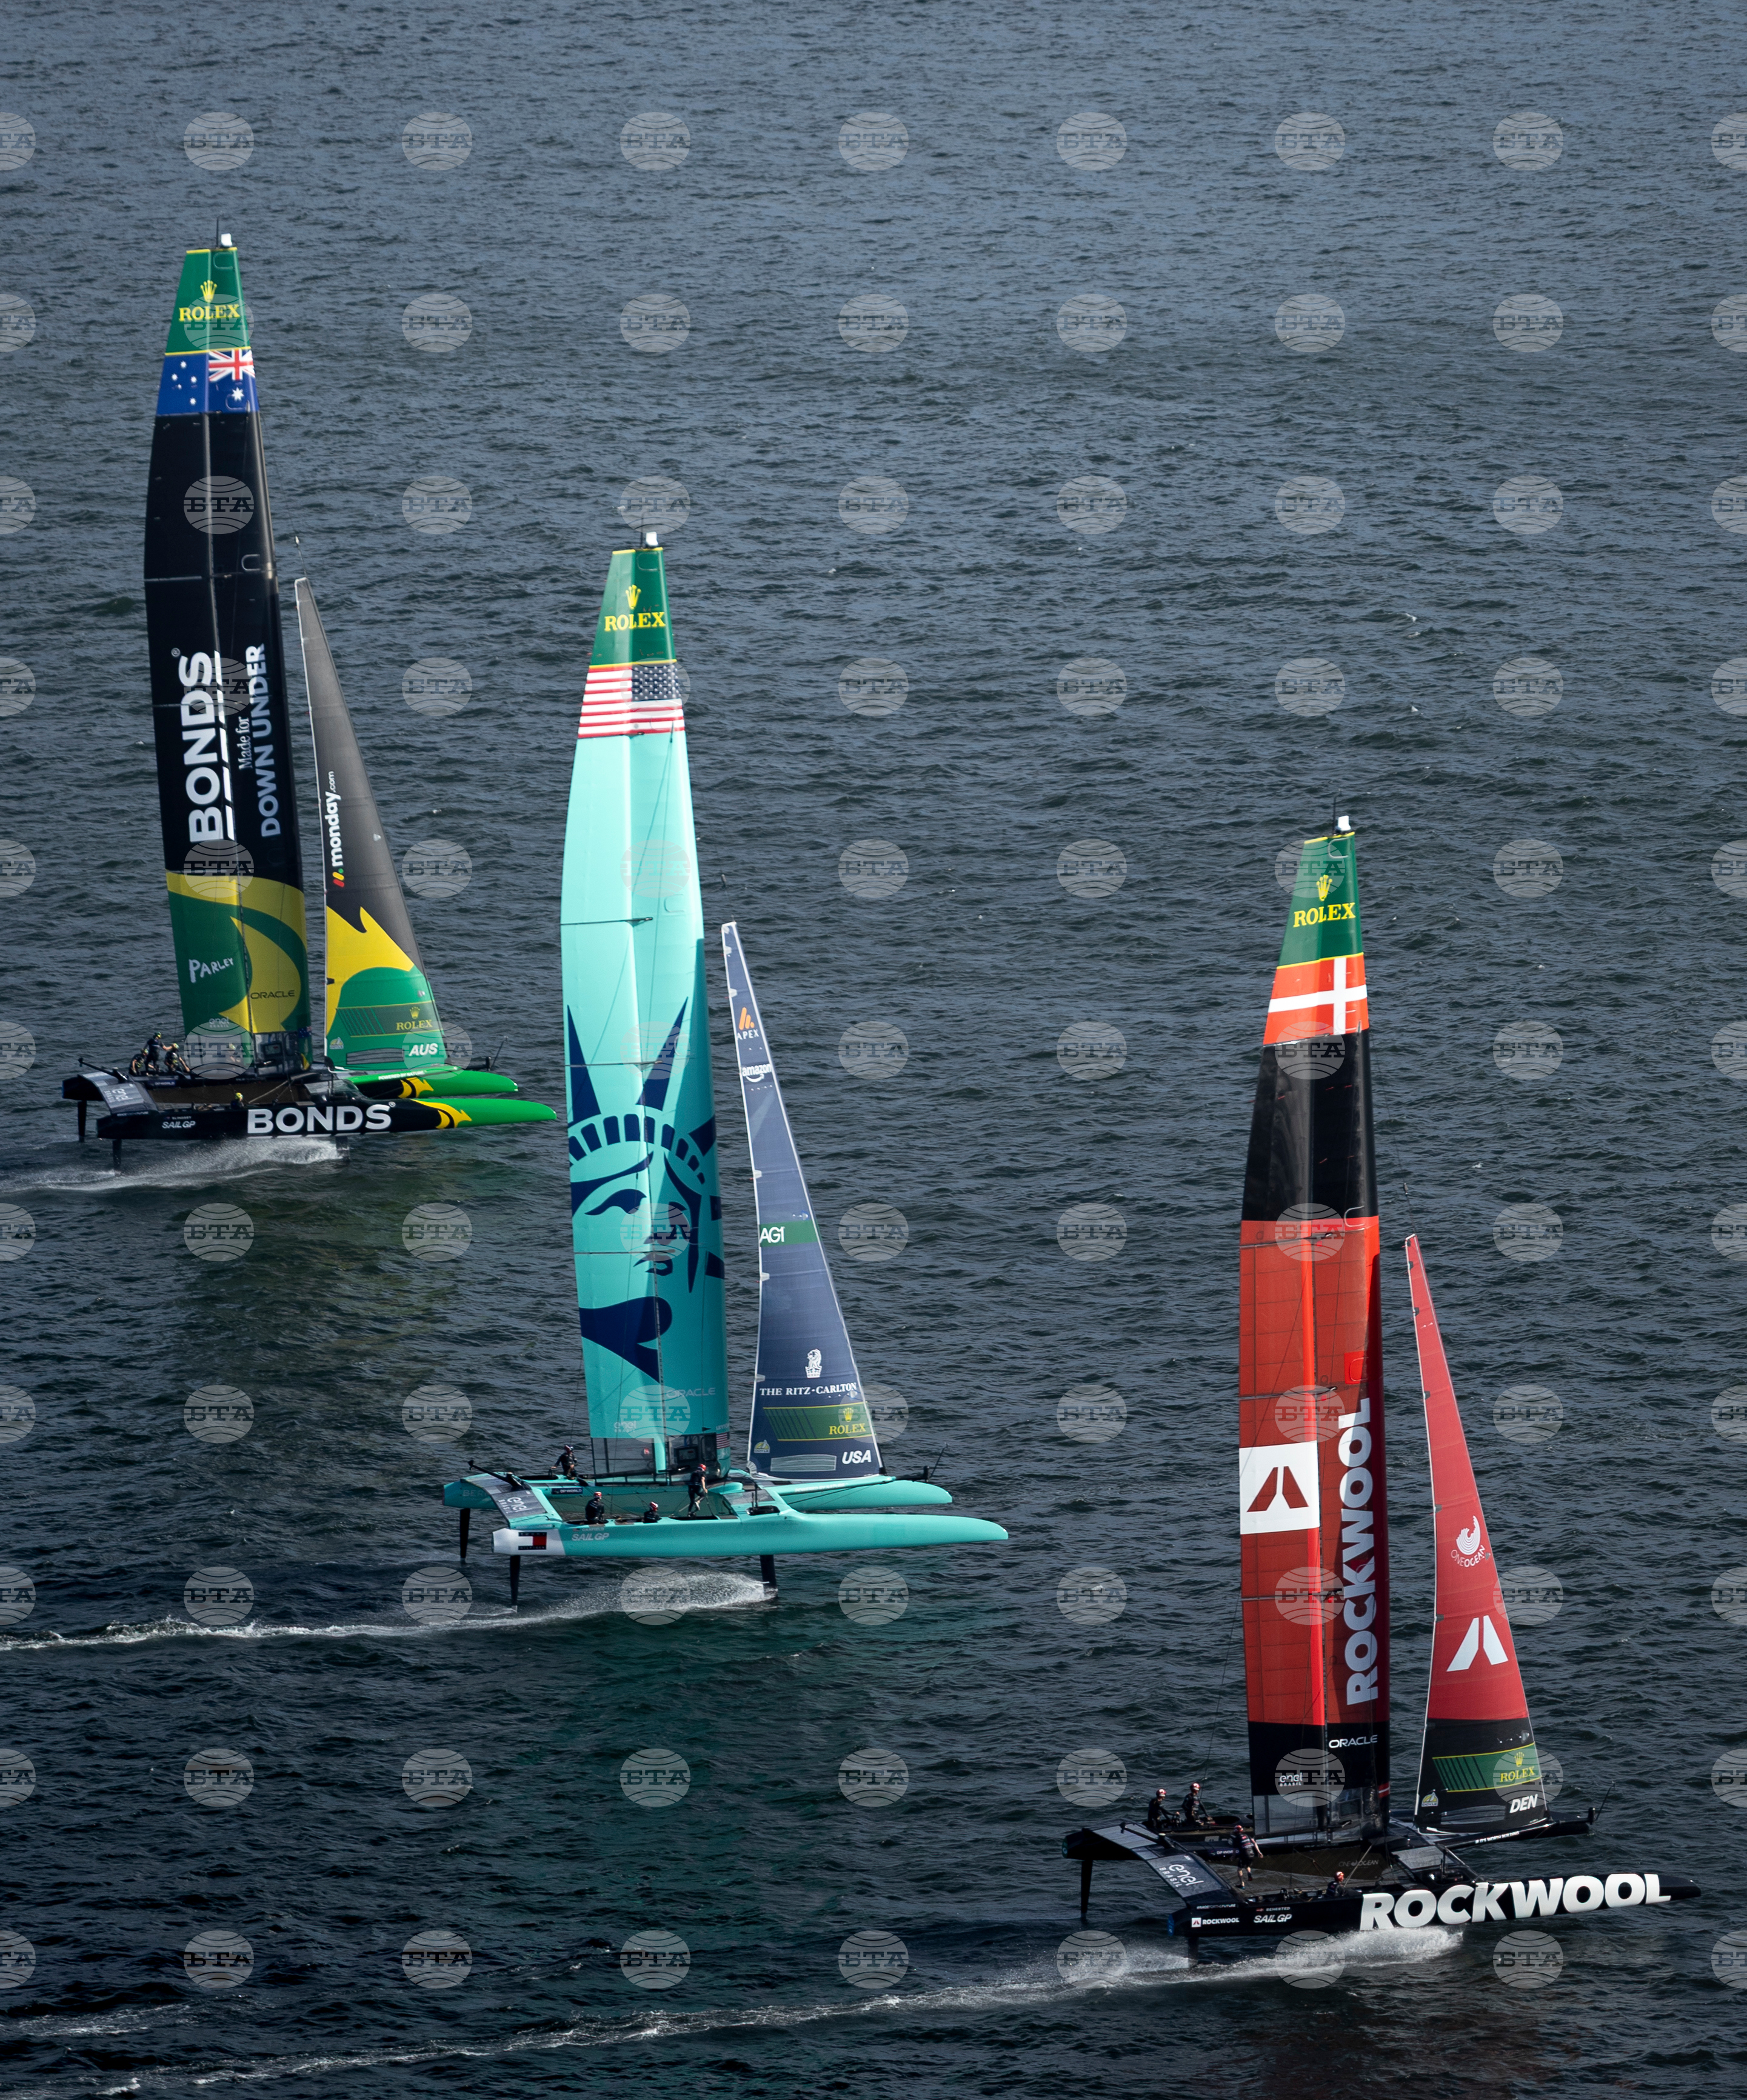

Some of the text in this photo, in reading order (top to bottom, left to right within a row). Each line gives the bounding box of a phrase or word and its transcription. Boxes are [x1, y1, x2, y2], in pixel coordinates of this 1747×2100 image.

[178, 304, 241, 322] ROLEX
[604, 611, 666, 632] ROLEX
[235, 716, 253, 770] Made for
[246, 644, 281, 838] DOWN UNDER
[324, 770, 342, 868] monday.com
[1293, 902, 1356, 927] ROLEX
[250, 990, 295, 999] ORACLE
[396, 1019, 433, 1031] ROLEX
[737, 1028, 760, 1041] APEX
[409, 1043, 438, 1056] AUS
[742, 1063, 772, 1076] amazon
[760, 1226, 784, 1244] AG1
[666, 1387, 716, 1399] ORACLE
[613, 1421, 636, 1429] enel
[829, 1423, 866, 1436] ROLEX
[842, 1450, 872, 1465] USA
[1338, 1397, 1378, 1705] ROCKWOOL
[1329, 1735, 1378, 1748] ORACLE
[1279, 1772, 1303, 1783] enel
[1499, 1766, 1535, 1783] ROLEX
[1509, 1794, 1538, 1813] DEN
[1158, 1867, 1183, 1888] BRASIL
[1168, 1864, 1204, 1887] enel
[1360, 1873, 1671, 1931] ROCKWOOL
